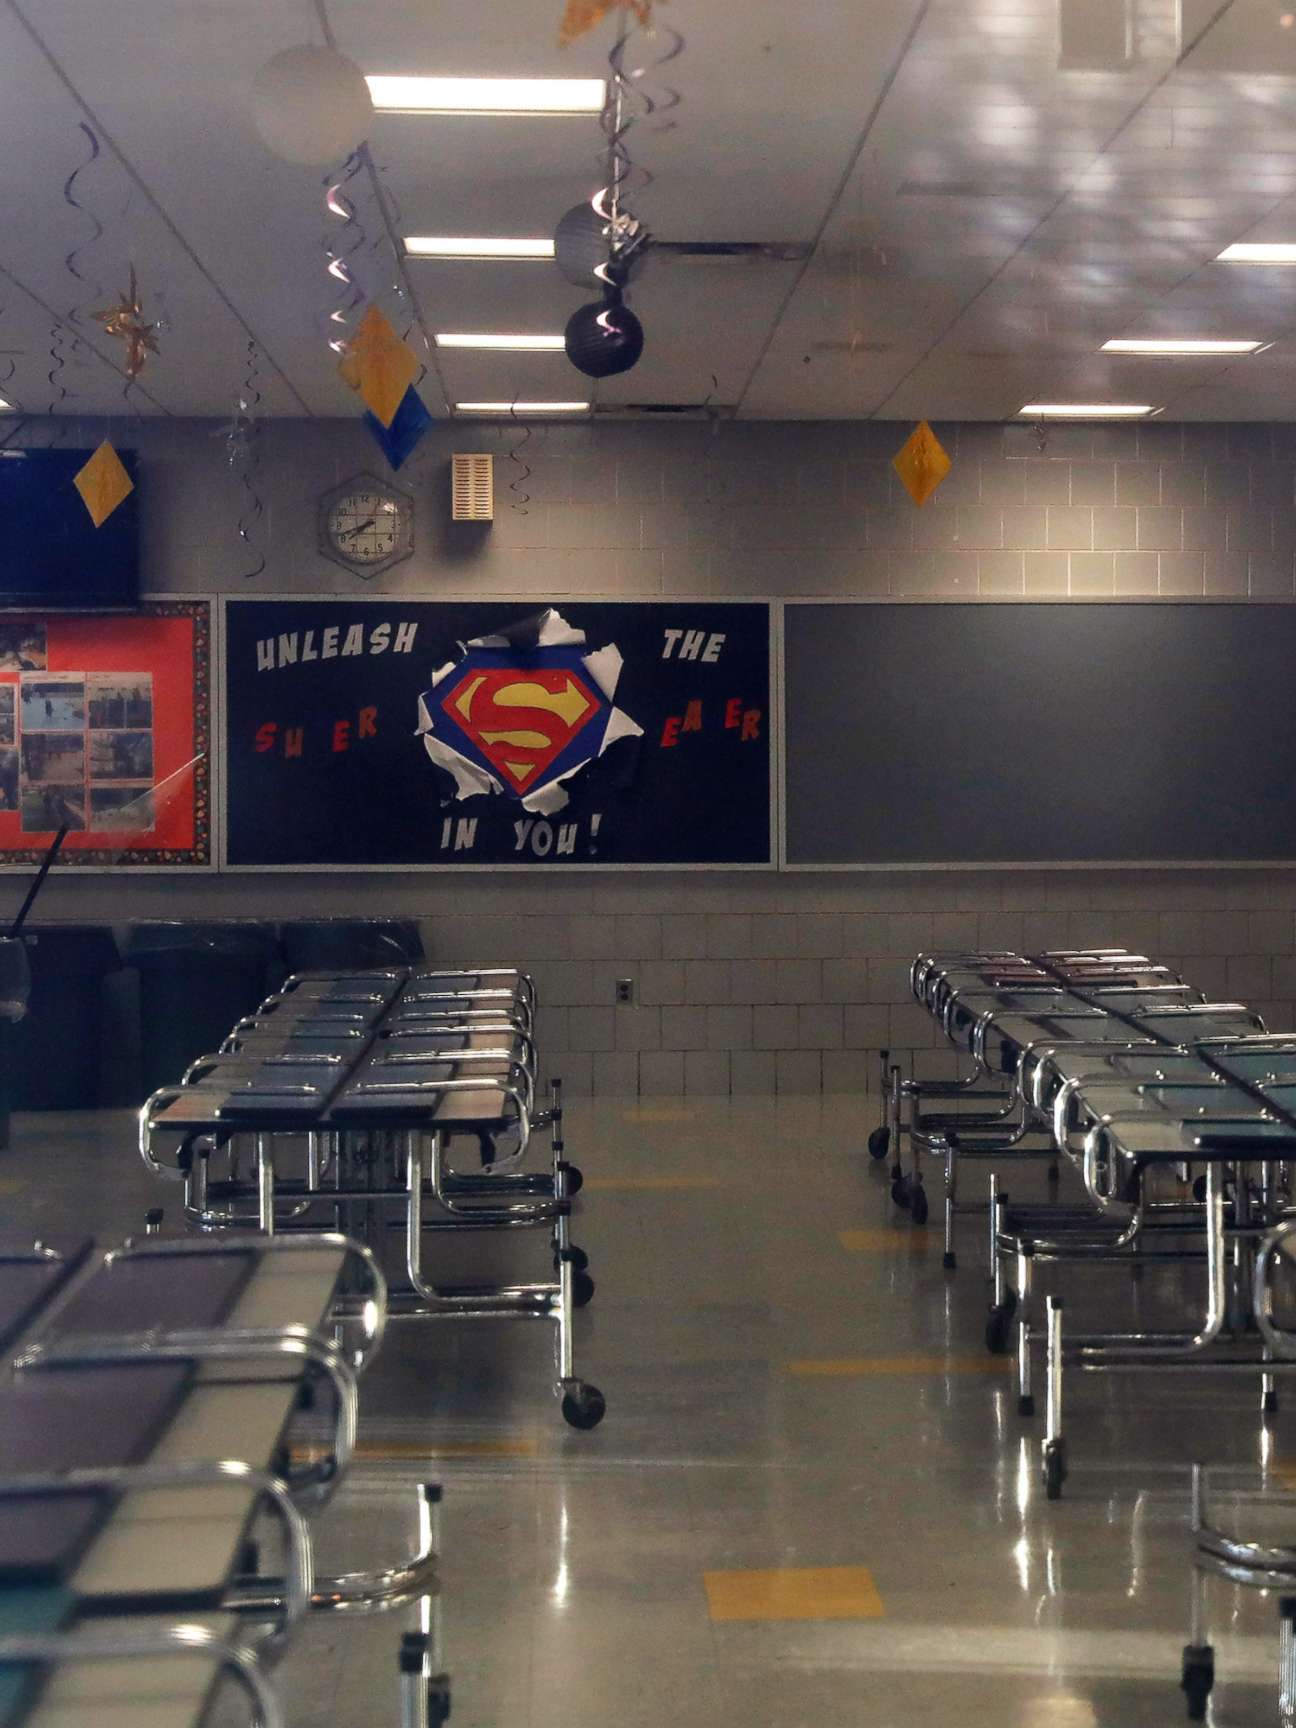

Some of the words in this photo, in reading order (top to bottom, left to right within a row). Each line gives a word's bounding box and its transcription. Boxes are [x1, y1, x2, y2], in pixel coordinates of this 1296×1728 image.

[256, 621, 419, 672] UNLEASH
[661, 628, 726, 663] THE
[440, 817, 478, 851] IN
